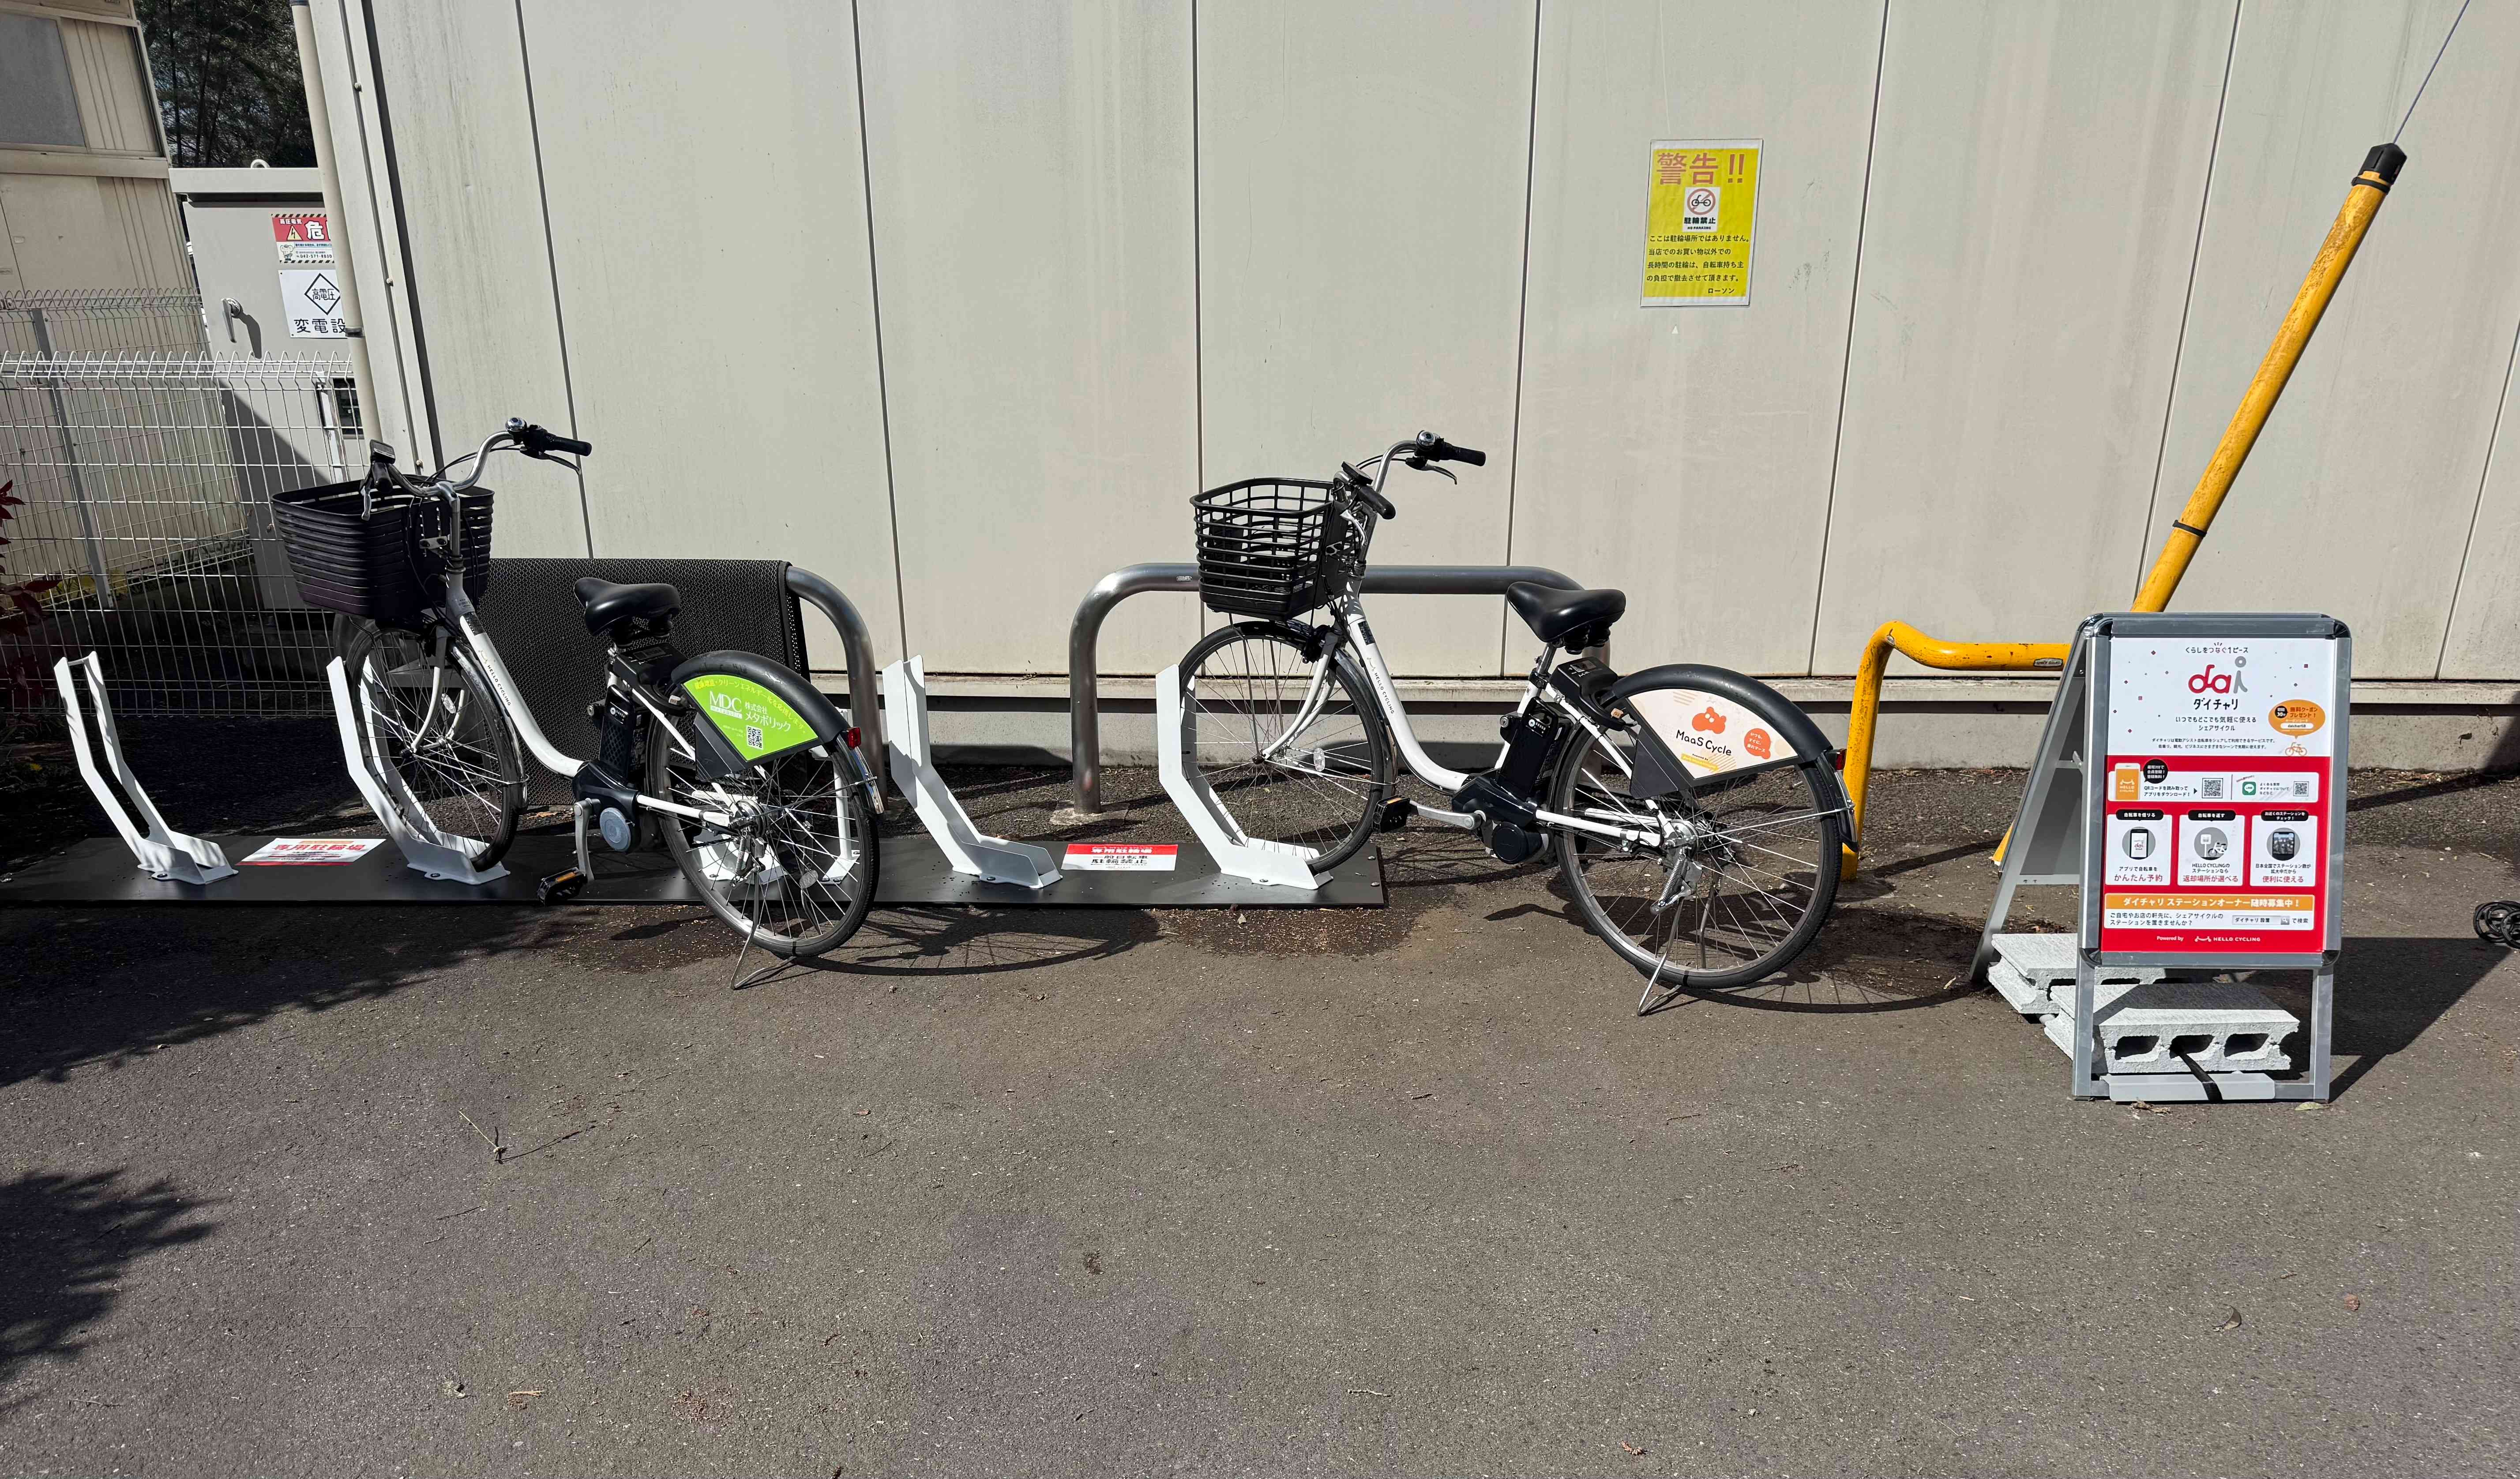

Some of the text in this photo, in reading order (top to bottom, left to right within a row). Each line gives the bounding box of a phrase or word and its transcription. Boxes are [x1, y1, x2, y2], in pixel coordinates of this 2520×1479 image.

[304, 220, 331, 241] 危
[312, 288, 336, 300] 高電圧
[293, 318, 346, 333] 変電設
[2188, 656, 2248, 693] dai
[487, 665, 511, 706] HELLO CYCLING
[1375, 673, 1394, 714] HELLO CYCLING
[710, 690, 742, 713] MDC
[745, 701, 768, 714] 株式会社
[2193, 698, 2238, 710] ダイチャリ
[745, 712, 791, 732] メタボリック
[1676, 729, 1732, 756] MaaS Cycle
[2123, 897, 2299, 907] ダイチャリ ステーションオーナー随時募集中！
